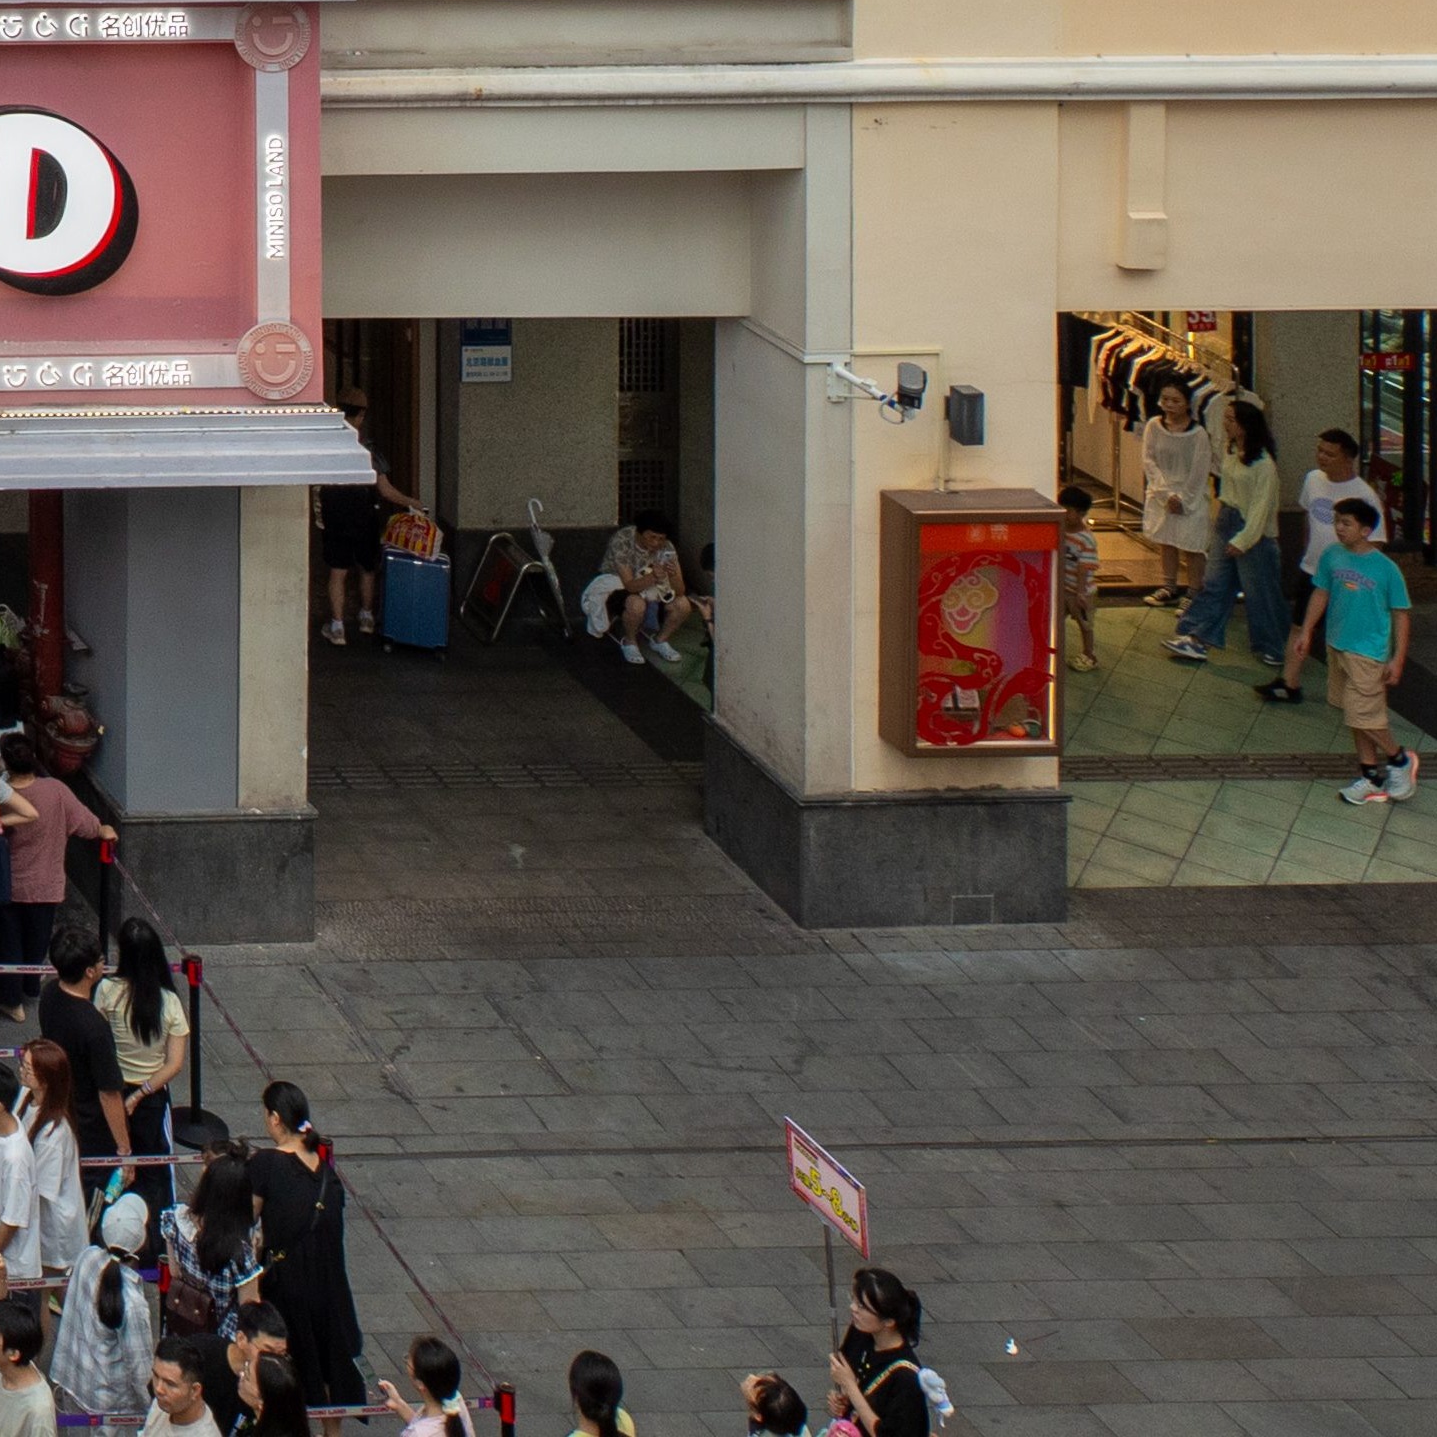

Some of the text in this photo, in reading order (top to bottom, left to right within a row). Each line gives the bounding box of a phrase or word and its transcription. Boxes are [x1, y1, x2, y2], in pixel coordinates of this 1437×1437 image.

[100, 11, 190, 39] 名创优品
[103, 361, 192, 387] 名创优品
